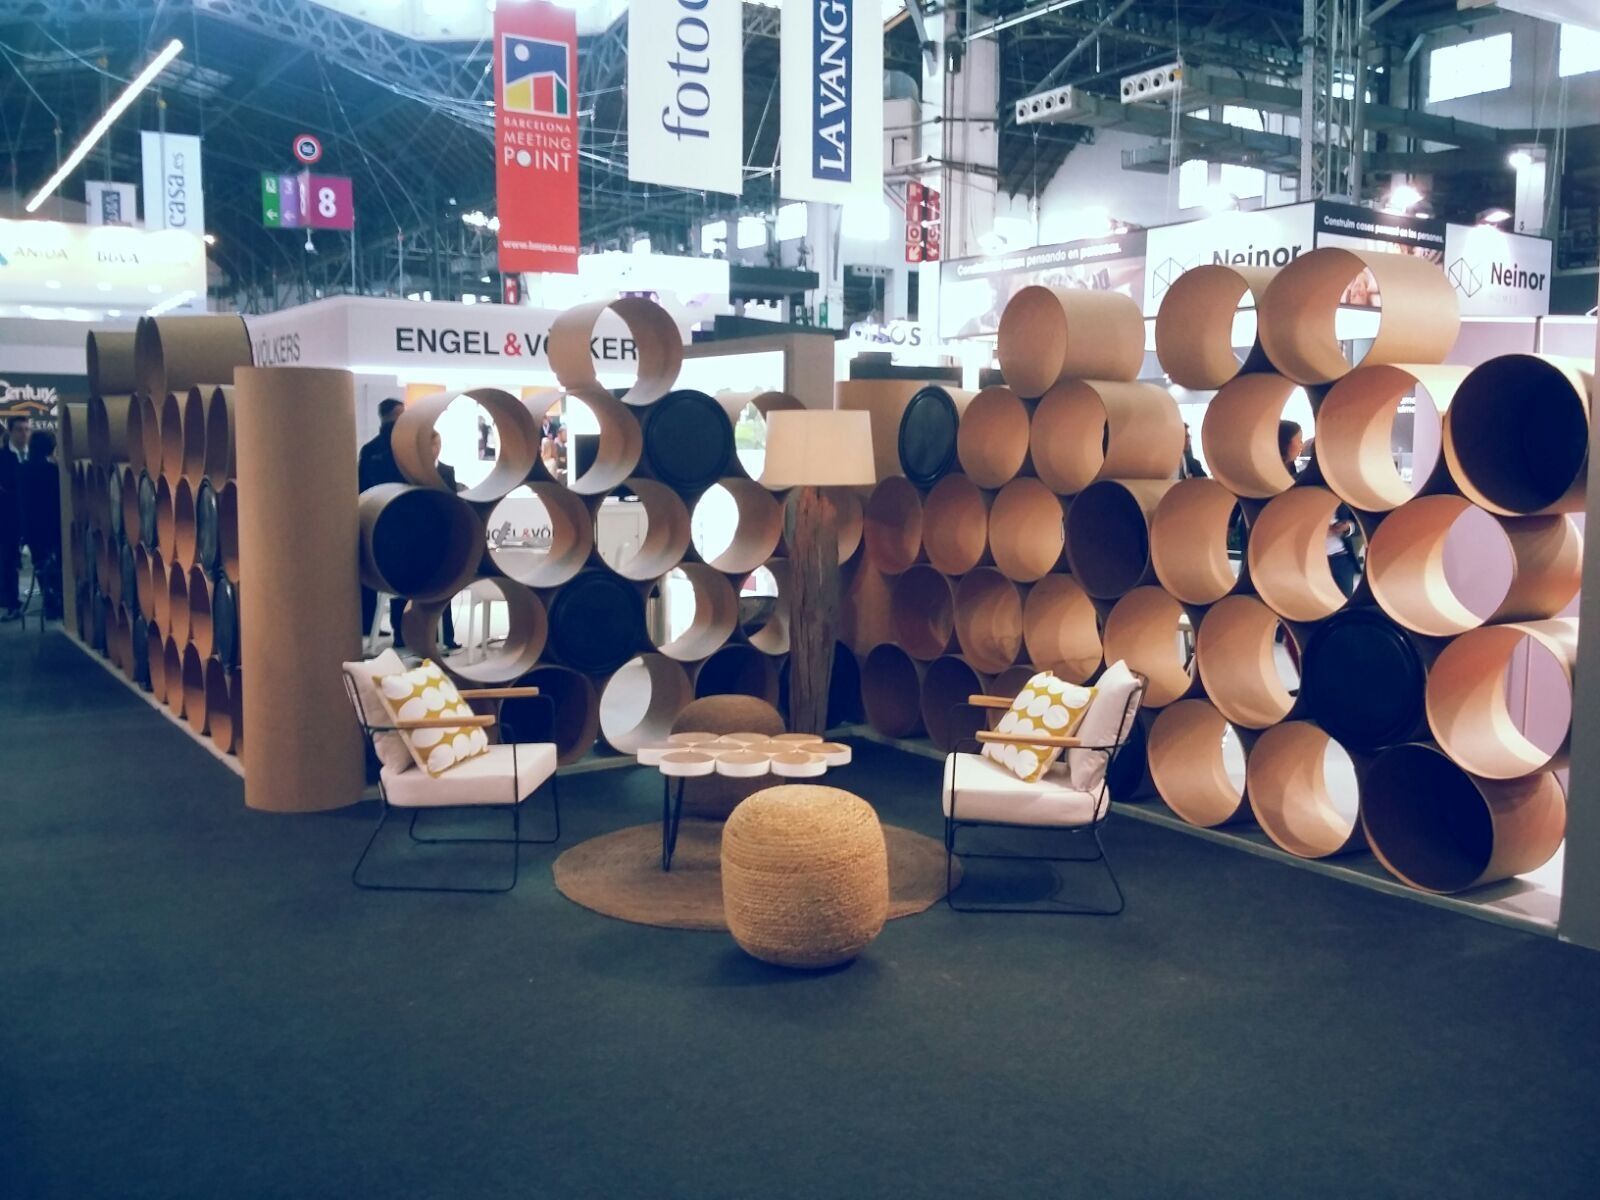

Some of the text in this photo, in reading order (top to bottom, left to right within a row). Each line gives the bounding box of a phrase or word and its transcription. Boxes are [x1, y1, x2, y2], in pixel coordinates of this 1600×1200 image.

[503, 115, 572, 134] BARCELONA
[503, 130, 573, 151] MEETING
[819, 119, 846, 173] LA
[503, 145, 572, 173] POINT
[318, 187, 337, 218] 8
[1490, 262, 1545, 291] Neinor
